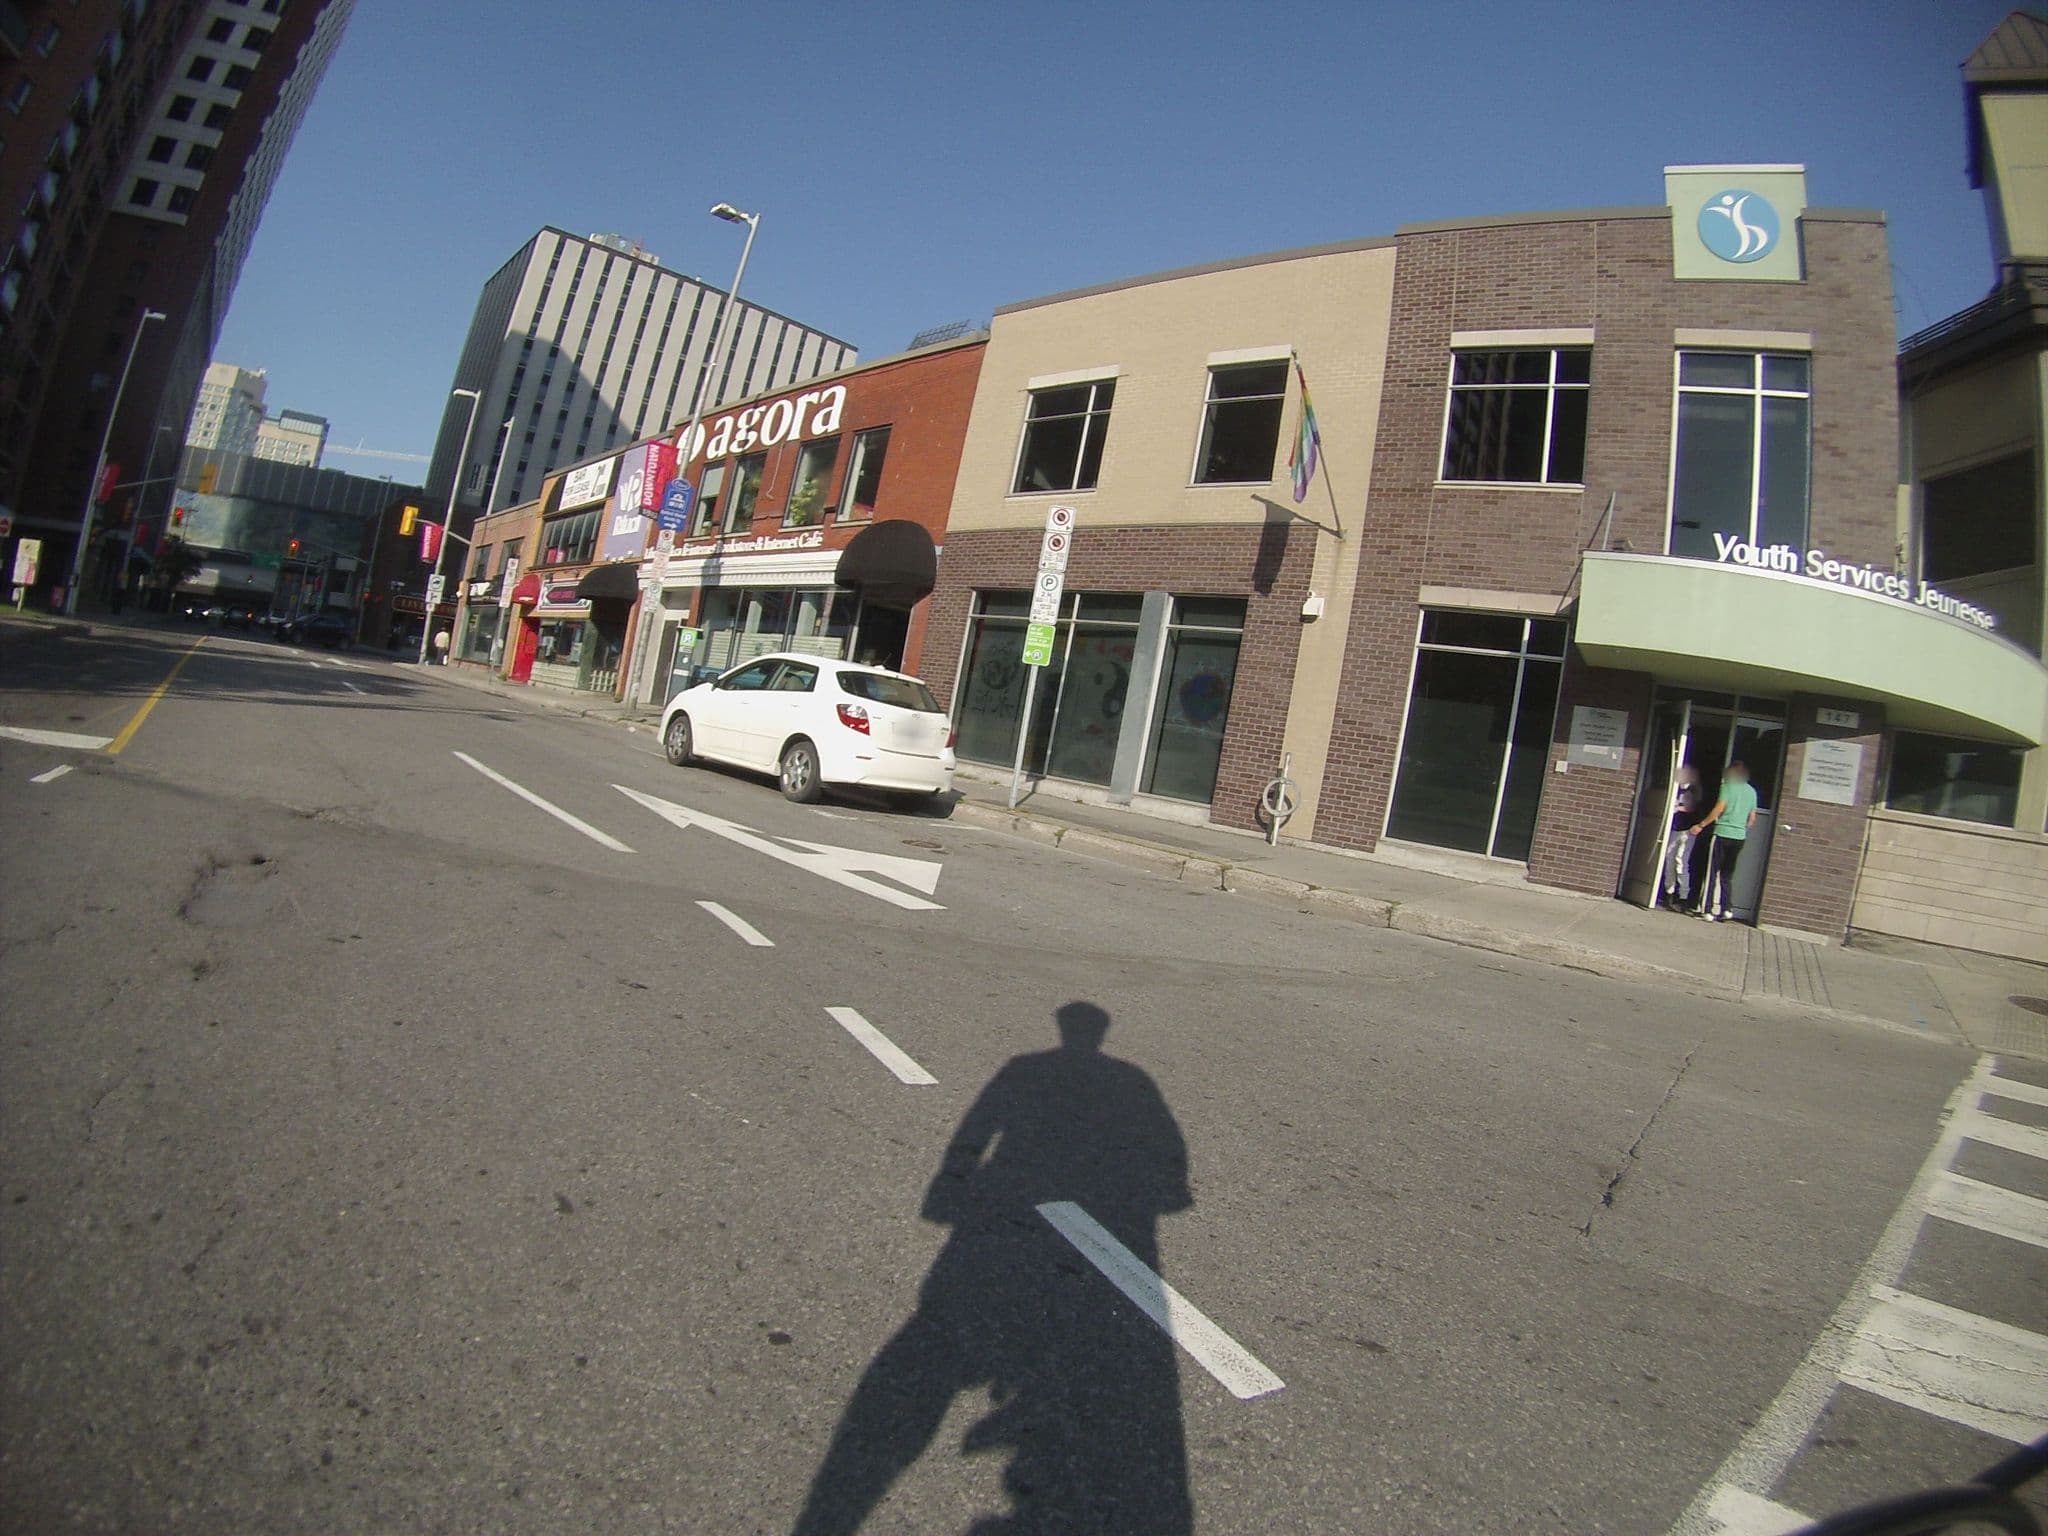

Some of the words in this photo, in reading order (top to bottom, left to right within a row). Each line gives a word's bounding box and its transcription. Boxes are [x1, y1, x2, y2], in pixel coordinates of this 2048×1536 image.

[643, 444, 660, 506] DOWNTOWN
[1712, 532, 1798, 573] Youth
[1805, 550, 1909, 600] Services
[1914, 580, 1995, 631] Jeunesse
